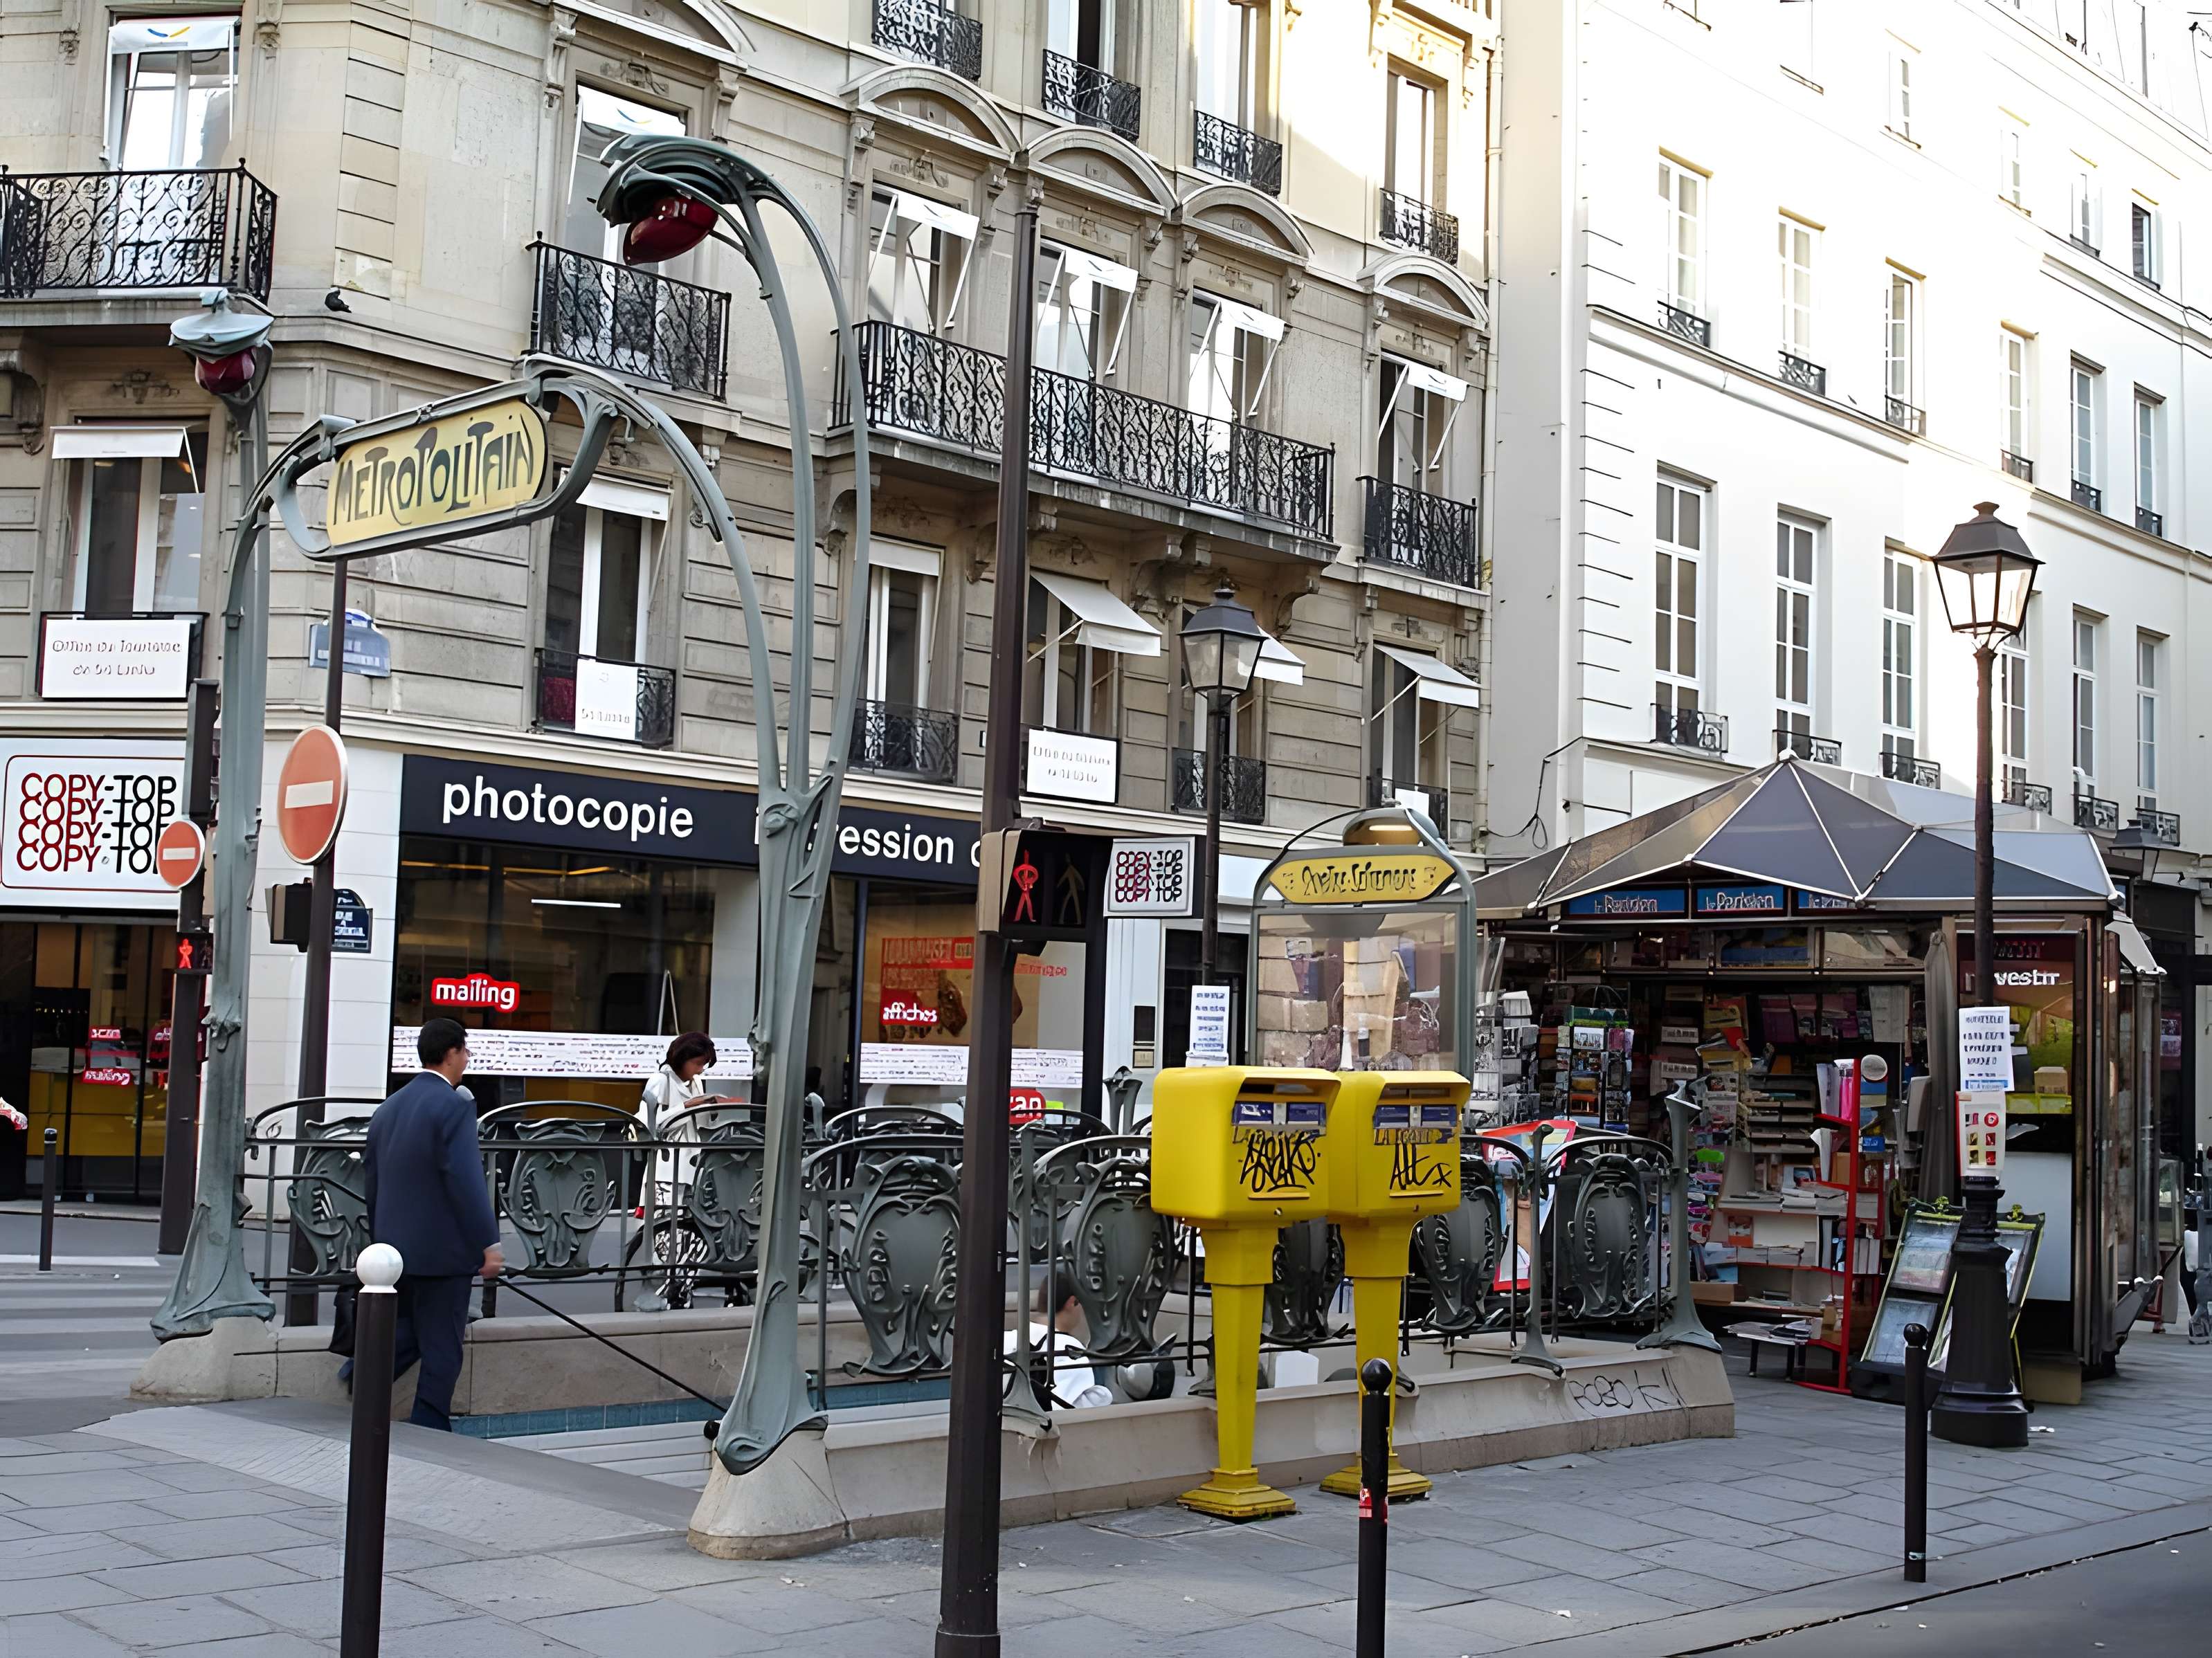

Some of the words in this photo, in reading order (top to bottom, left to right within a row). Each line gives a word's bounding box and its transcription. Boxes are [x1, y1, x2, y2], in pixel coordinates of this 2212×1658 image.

[334, 414, 534, 526] METROPOLITAIN
[21, 772, 177, 802] COPY-TOP
[19, 797, 176, 826] COPY-TOP
[442, 775, 693, 842] photocopie
[435, 978, 516, 1010] mailing
